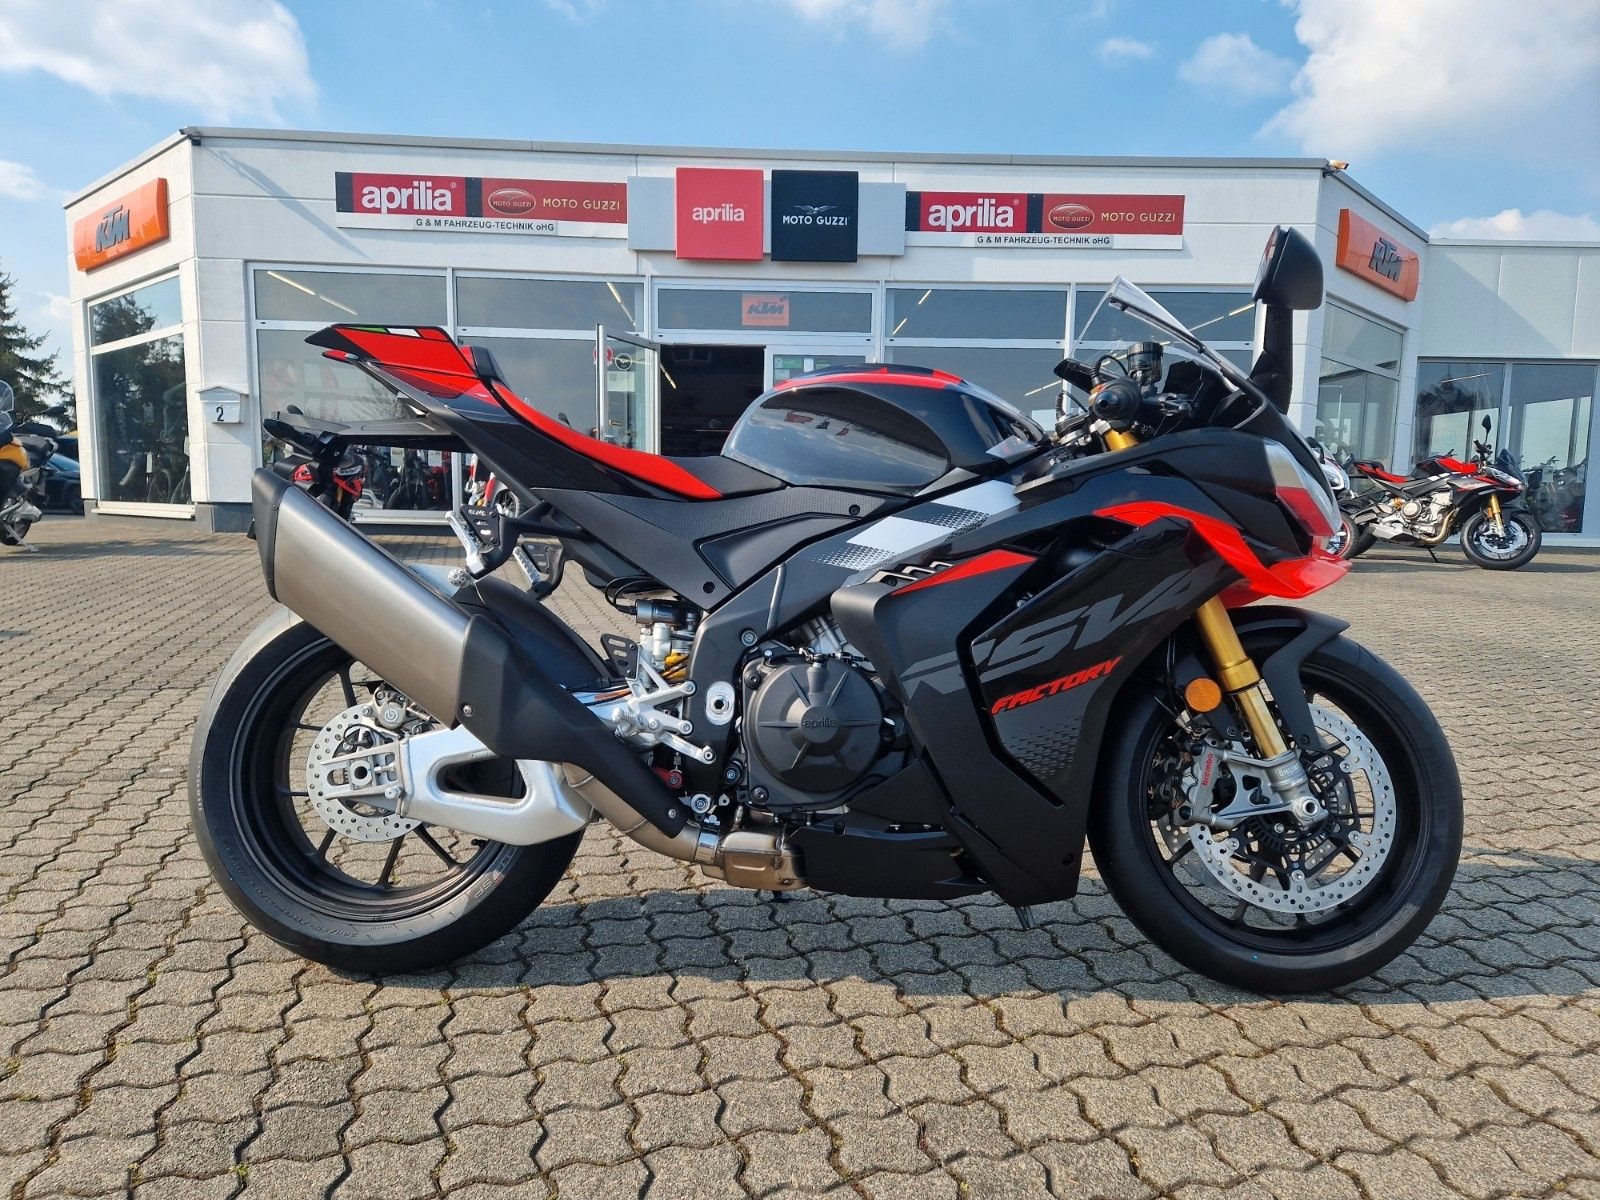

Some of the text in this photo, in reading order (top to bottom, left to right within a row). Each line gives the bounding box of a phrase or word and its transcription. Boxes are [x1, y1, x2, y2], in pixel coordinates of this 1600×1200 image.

[361, 180, 452, 214] aprilia
[543, 198, 620, 211] MOTO GUZZI
[692, 203, 745, 224] aprilia
[782, 215, 848, 226] MOTO GUZZI
[928, 198, 1014, 231] aprilia
[1101, 212, 1176, 223] MOTO GUZZI
[95, 204, 130, 253] KTM
[416, 218, 555, 231] G & M FAHRZEUG-TECHNIK oHG
[977, 236, 1110, 245] G & M FAHRZEUG-TECHNIK oHG
[1368, 237, 1402, 282] KTM
[747, 301, 784, 314] KTM
[215, 406, 224, 422] 2
[991, 655, 1124, 716] FACTORY
[804, 717, 835, 729] aprilia
[1201, 753, 1215, 786] brembo
